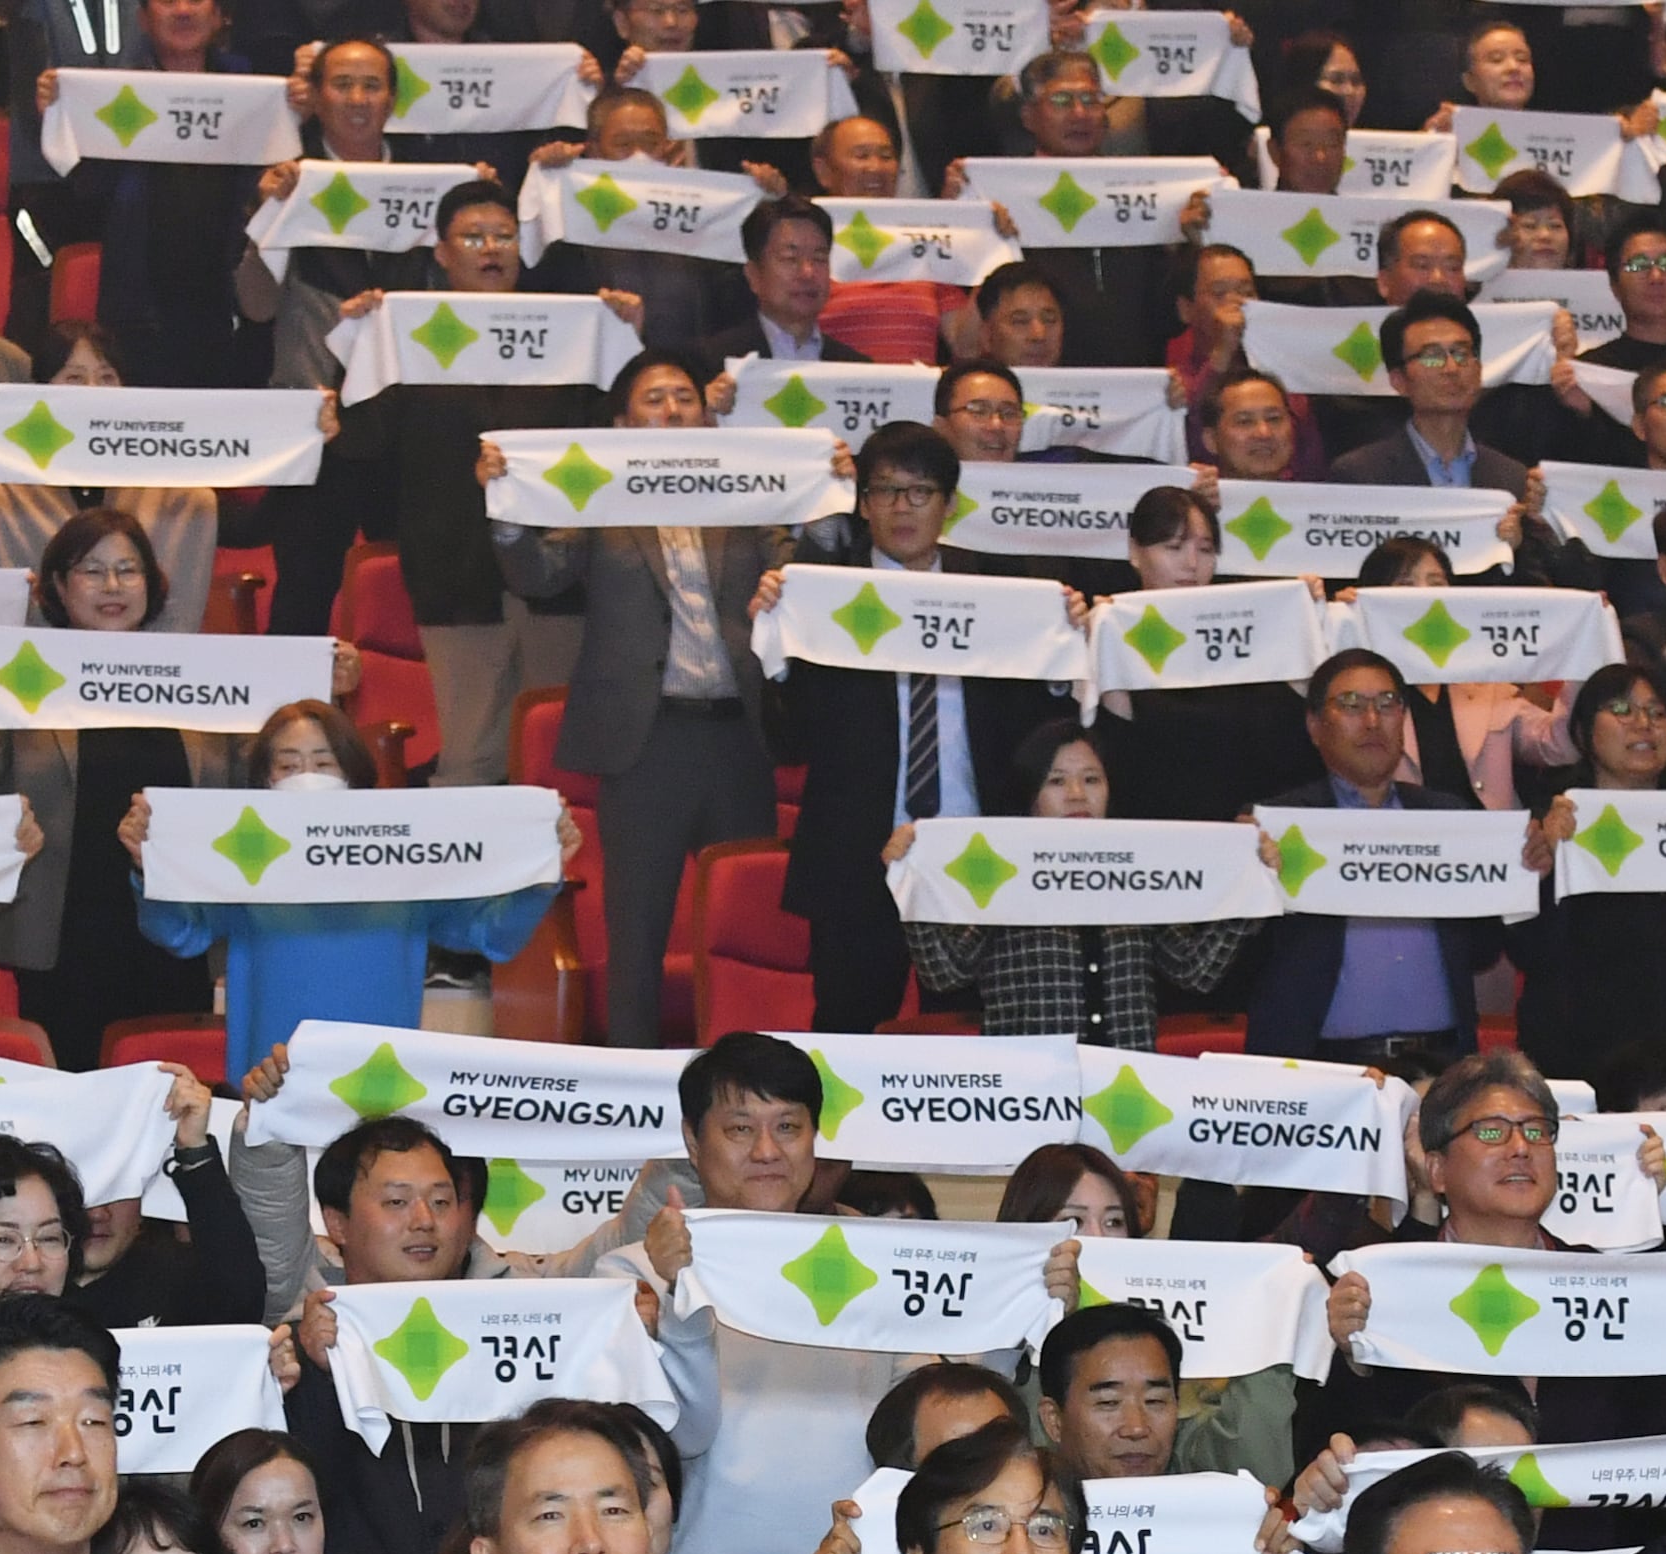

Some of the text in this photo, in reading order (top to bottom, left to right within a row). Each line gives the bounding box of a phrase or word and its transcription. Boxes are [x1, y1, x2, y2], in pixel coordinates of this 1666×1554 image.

[727, 87, 780, 115] 경산
[648, 201, 703, 234] 경산
[489, 329, 547, 359] 경산
[90, 420, 184, 432] MY UNIVERSE
[89, 437, 249, 457] GYEONGSAN
[913, 615, 974, 650] 경산
[1196, 626, 1253, 661] 경산
[1481, 625, 1539, 657] 경산
[80, 681, 249, 705] GYEONGSAN
[307, 825, 410, 837] MY UNIVERSE
[306, 842, 482, 865] GYEONGSAN
[1033, 852, 1133, 863] MY UNIVERSE
[1032, 870, 1202, 890] GYEONGSAN
[450, 1072, 579, 1092] MY UNIVERSE
[882, 1074, 1002, 1088] MY UNIVERSE
[443, 1091, 663, 1128] GYEONGSAN
[882, 1096, 1082, 1122] GYEONGSAN
[1193, 1096, 1308, 1116] MY UNIVERSE
[1189, 1119, 1381, 1152] GYEONGSAN
[892, 1269, 972, 1317] 경산
[1552, 1297, 1629, 1341] 경산
[482, 1335, 560, 1382] 경산
